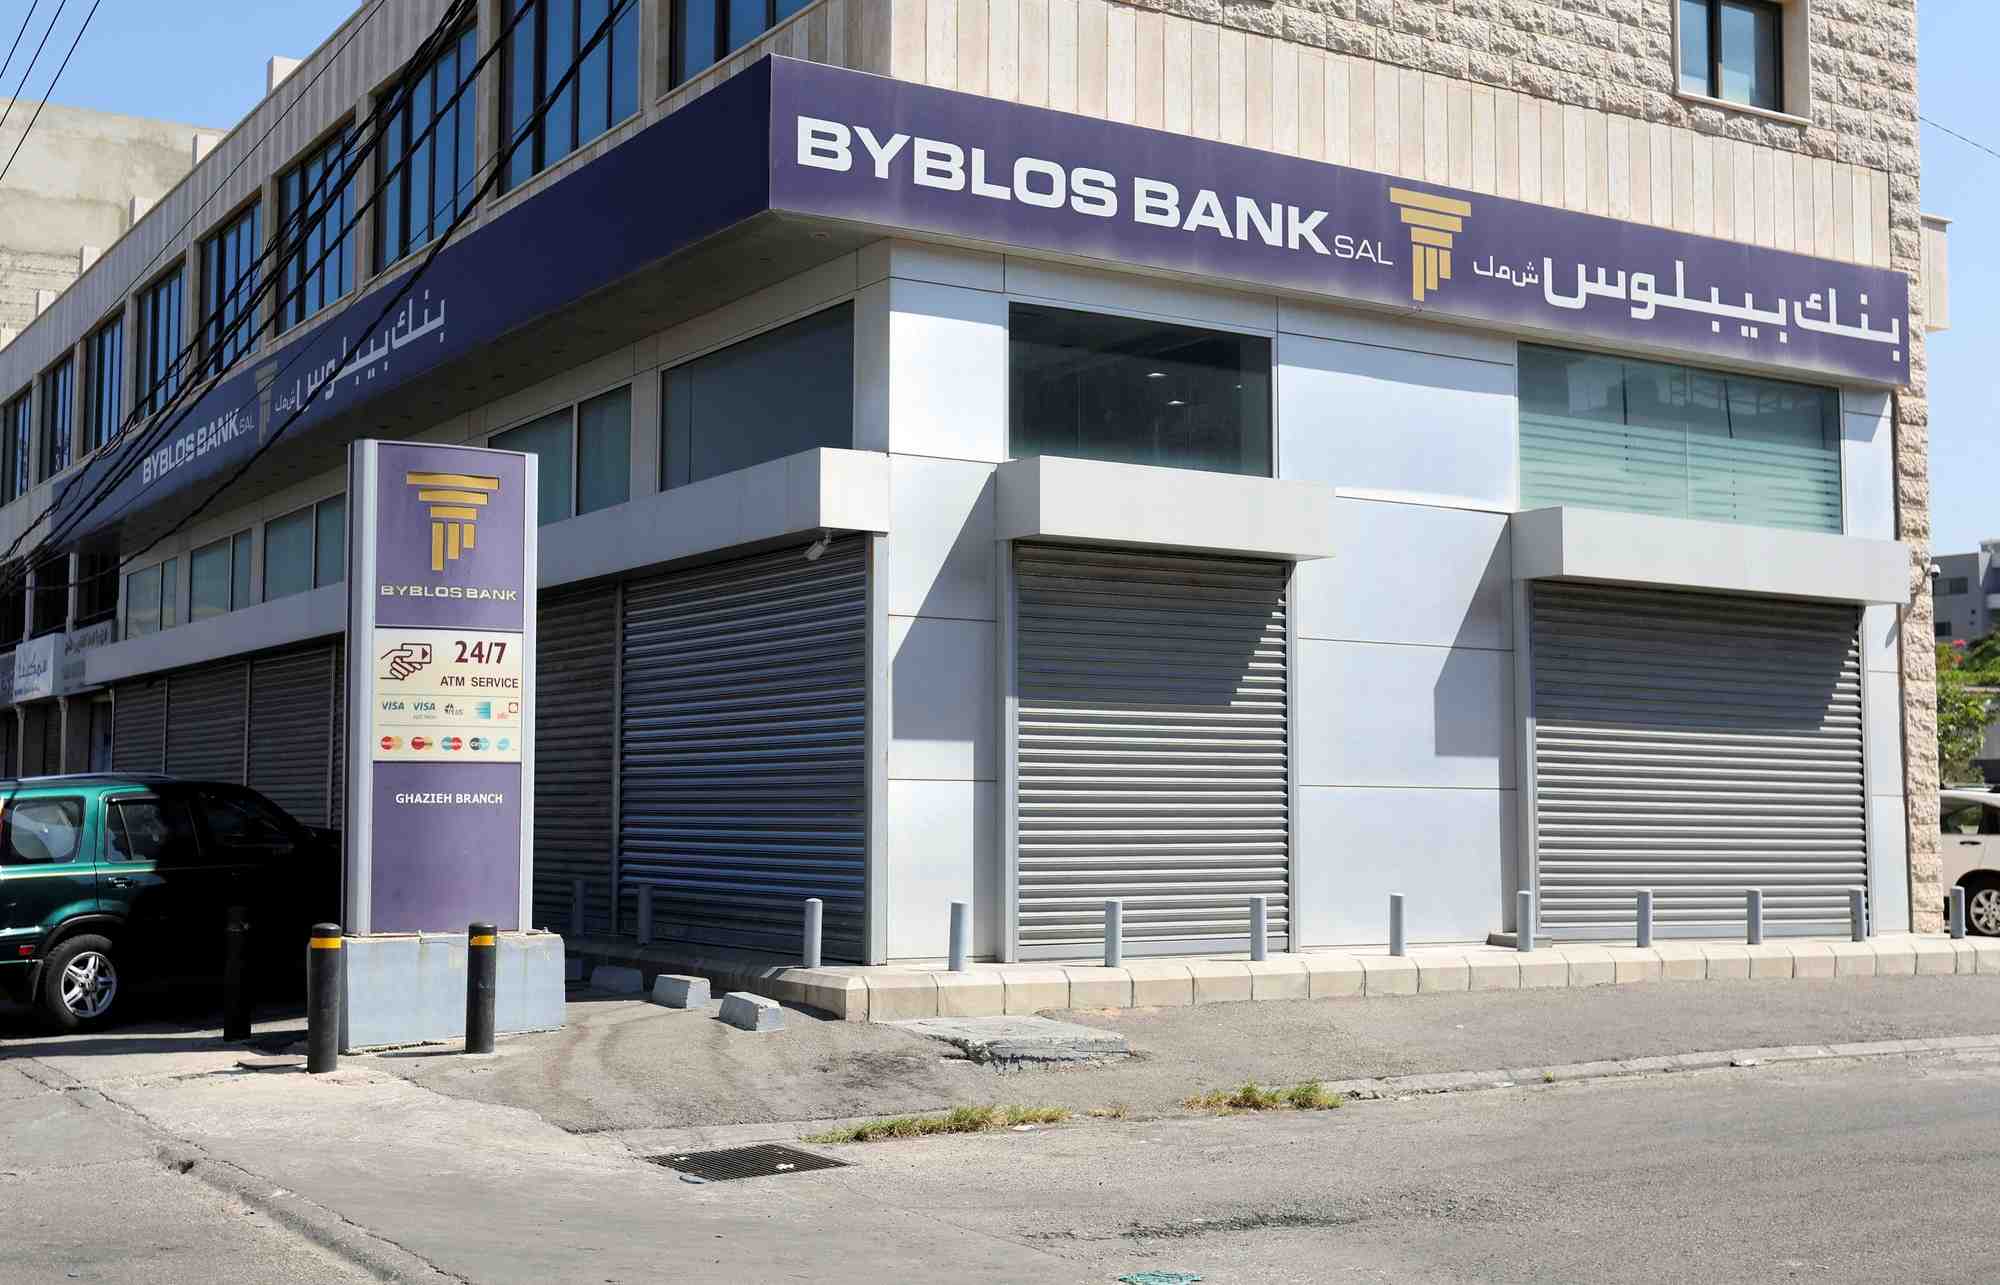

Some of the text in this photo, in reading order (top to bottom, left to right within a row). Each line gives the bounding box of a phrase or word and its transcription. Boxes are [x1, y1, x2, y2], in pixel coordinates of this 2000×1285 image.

[796, 115, 1394, 266] BYBLOS BANK SAL
[1542, 256, 1789, 344] بيبلوس
[391, 288, 446, 350] بنك
[1793, 287, 1901, 361] بنك
[142, 432, 195, 485] BYBLOS
[196, 407, 241, 457] BANK
[380, 585, 518, 601] BYBLOS BANK
[454, 640, 508, 665] 24/7
[439, 676, 519, 688] ATM SERVICE
[382, 701, 405, 711] VISA
[413, 702, 436, 711] VISA
[395, 793, 503, 805] GHAZIEH BRANCH
